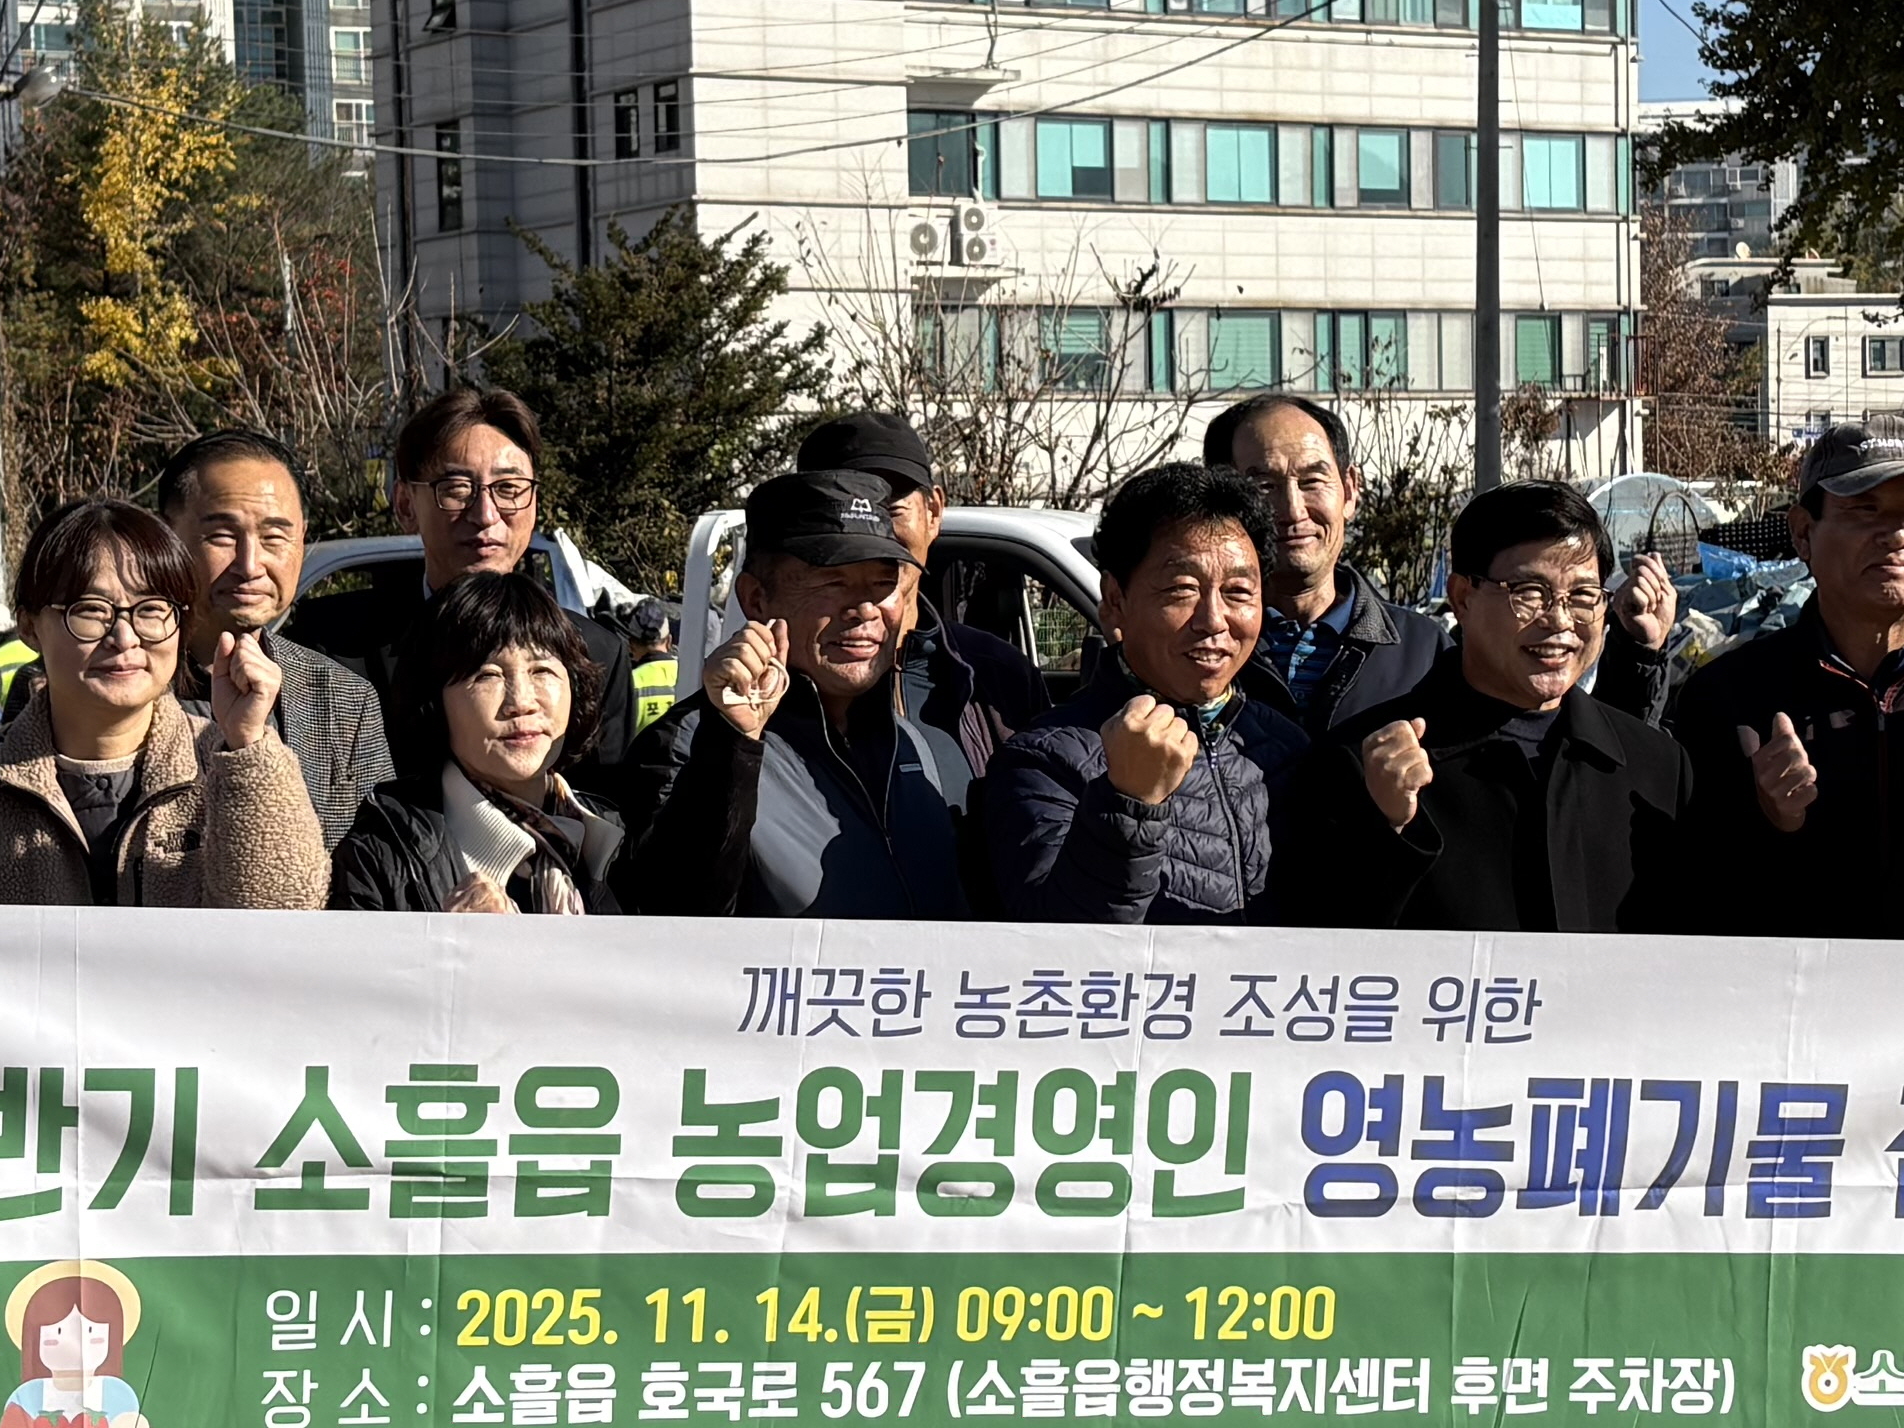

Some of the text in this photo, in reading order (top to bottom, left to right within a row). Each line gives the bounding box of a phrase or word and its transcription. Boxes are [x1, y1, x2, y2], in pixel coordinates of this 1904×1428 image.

[737, 967, 1543, 1045] 깨끗한 농촌환경 조성을 위한
[253, 1064, 622, 1219] 소흘읍
[671, 1066, 1253, 1219] 농업경영인
[1300, 1070, 1849, 1220] 영농폐기물
[457, 1288, 619, 1348] 2025.
[646, 1288, 730, 1345] 11.
[755, 1286, 936, 1345] 14.(금)
[955, 1285, 1115, 1343] 09:00
[1184, 1285, 1337, 1342] 12:00
[451, 1362, 618, 1427] 소흘읍
[637, 1360, 800, 1422] 호국로
[819, 1360, 926, 1420] 567
[946, 1357, 1432, 1419] (소흘읍행정복지센터
[1449, 1355, 1550, 1416] 후면
[1567, 1356, 1736, 1416] 주차장)
